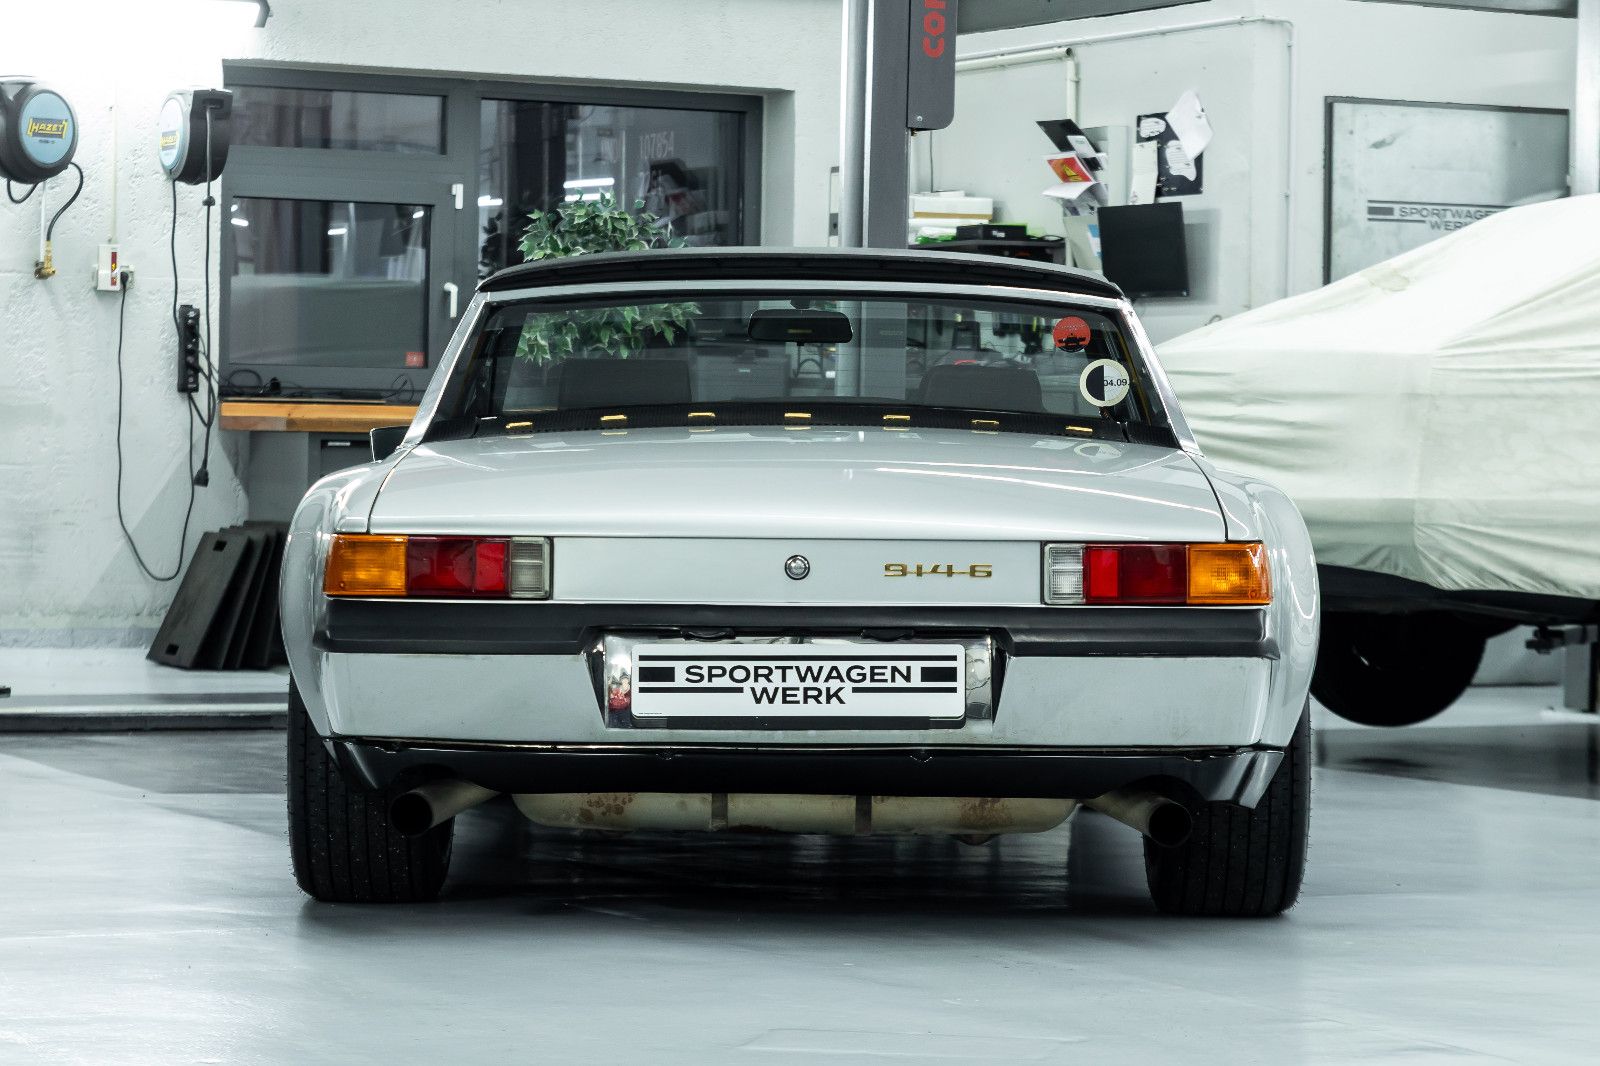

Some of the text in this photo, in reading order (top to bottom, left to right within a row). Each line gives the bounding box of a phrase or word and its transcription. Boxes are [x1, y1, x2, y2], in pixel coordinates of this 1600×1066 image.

[31, 121, 64, 133] HAZET
[685, 664, 911, 684] SPORTWAGEN
[750, 686, 846, 705] WERK
